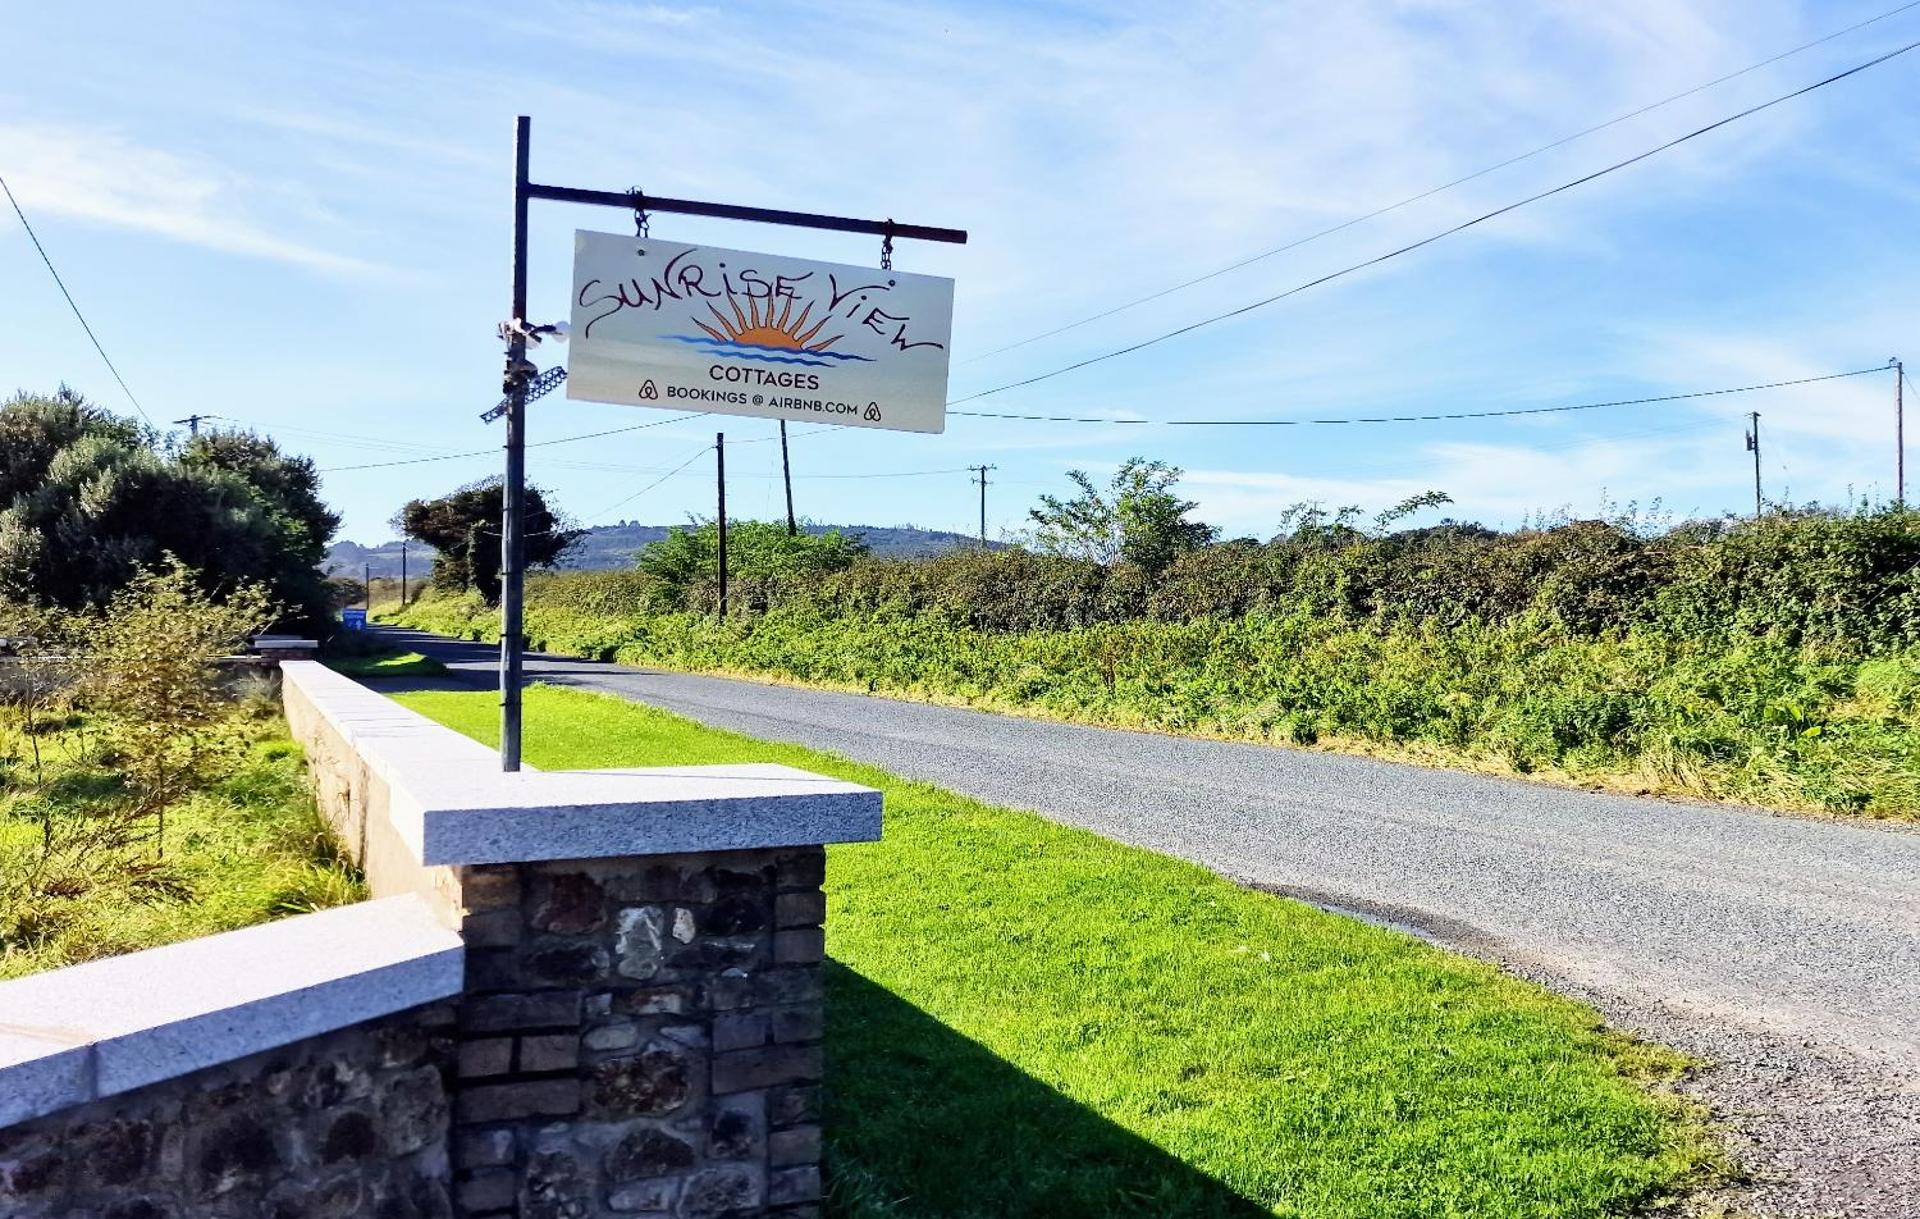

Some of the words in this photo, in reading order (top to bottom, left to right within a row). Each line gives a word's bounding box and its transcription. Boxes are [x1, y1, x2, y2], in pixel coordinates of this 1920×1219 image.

[709, 365, 820, 391] COTTAGES
[667, 385, 748, 404] BOOKINGS
[752, 394, 764, 407] @
[768, 396, 858, 416] AIRBNB.COM
